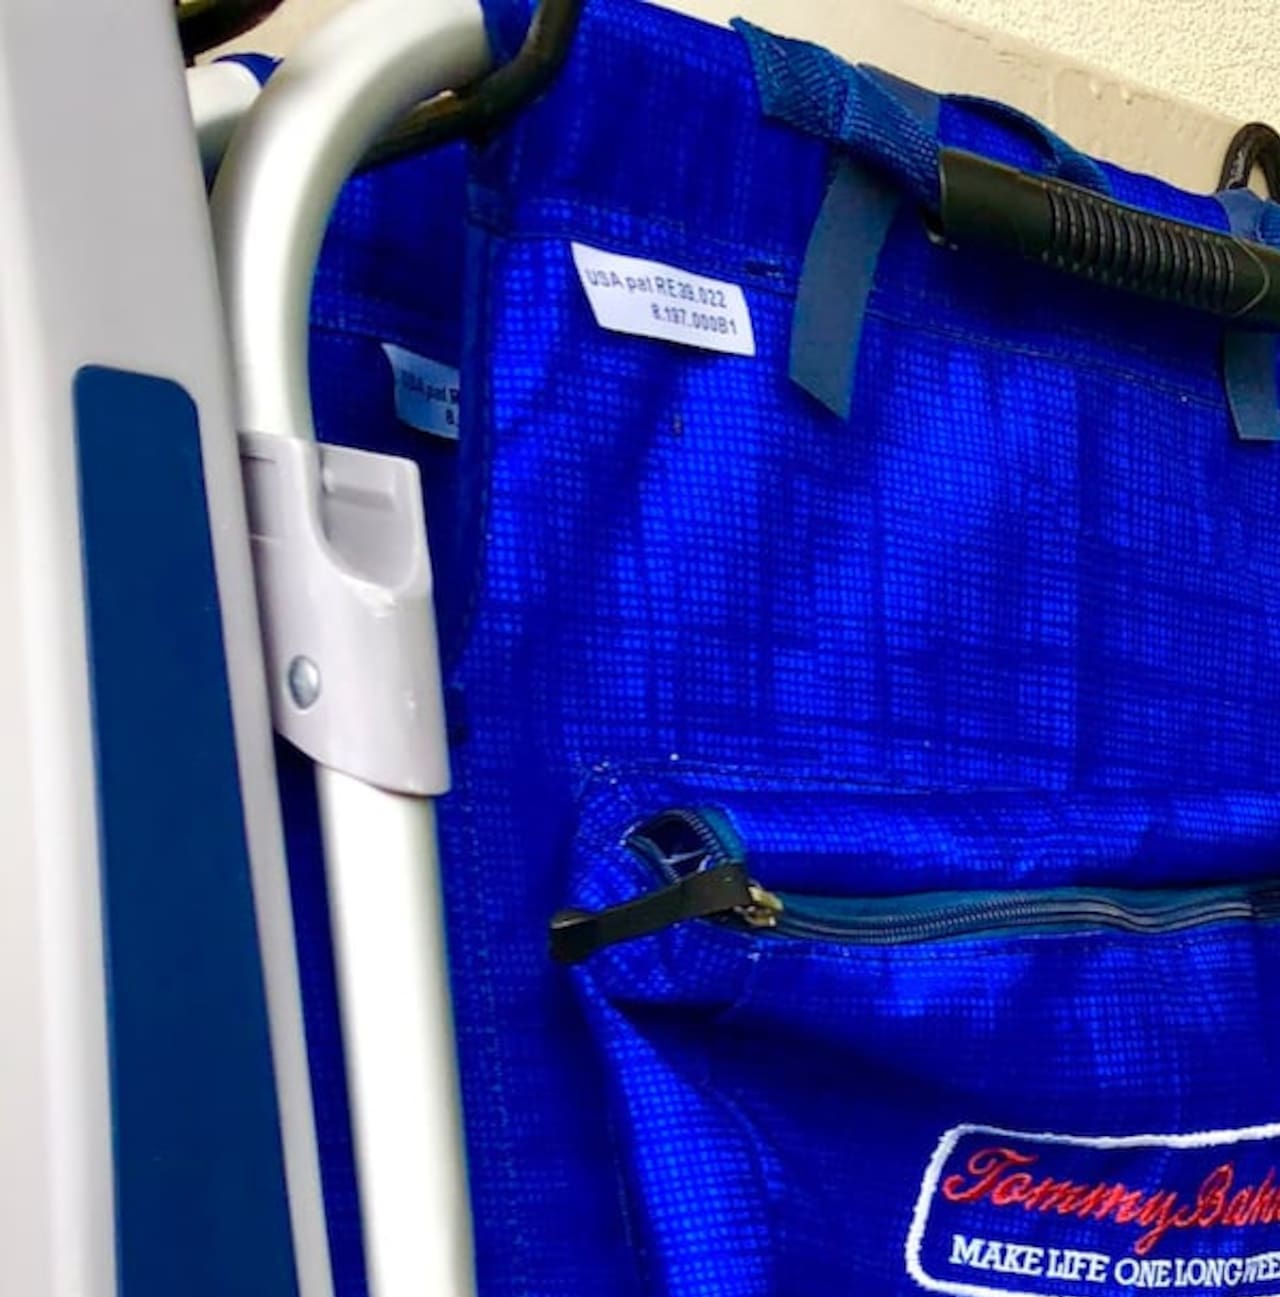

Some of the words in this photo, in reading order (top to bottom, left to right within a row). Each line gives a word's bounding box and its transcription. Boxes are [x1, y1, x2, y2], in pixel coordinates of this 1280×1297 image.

[585, 269, 623, 288] USA
[625, 277, 651, 295] pat
[942, 1147, 1176, 1255] Tommy
[949, 1234, 1045, 1277] MAKE
[1048, 1248, 1110, 1284] LIFE
[1115, 1257, 1172, 1287] ONE
[1174, 1258, 1244, 1287] LONG
